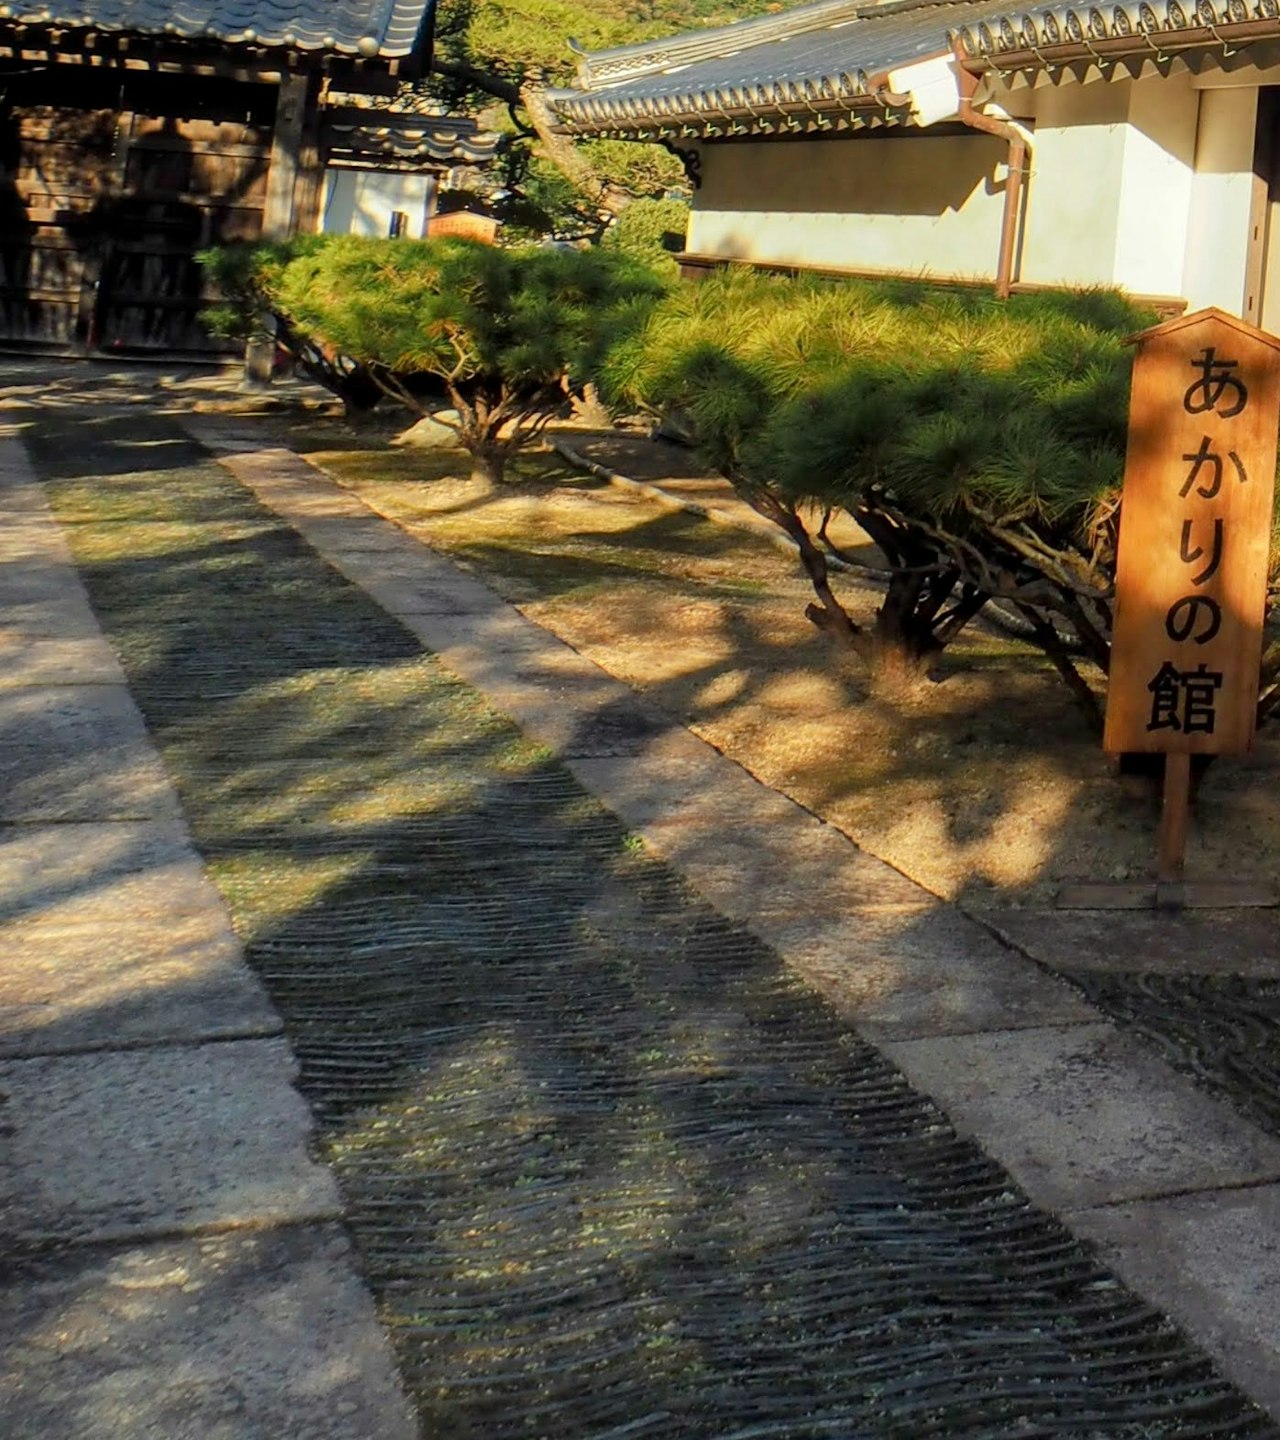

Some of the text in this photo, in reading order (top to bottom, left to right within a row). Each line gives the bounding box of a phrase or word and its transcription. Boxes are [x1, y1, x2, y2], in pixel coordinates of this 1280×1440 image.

[1146, 346, 1248, 735] あかりの館
